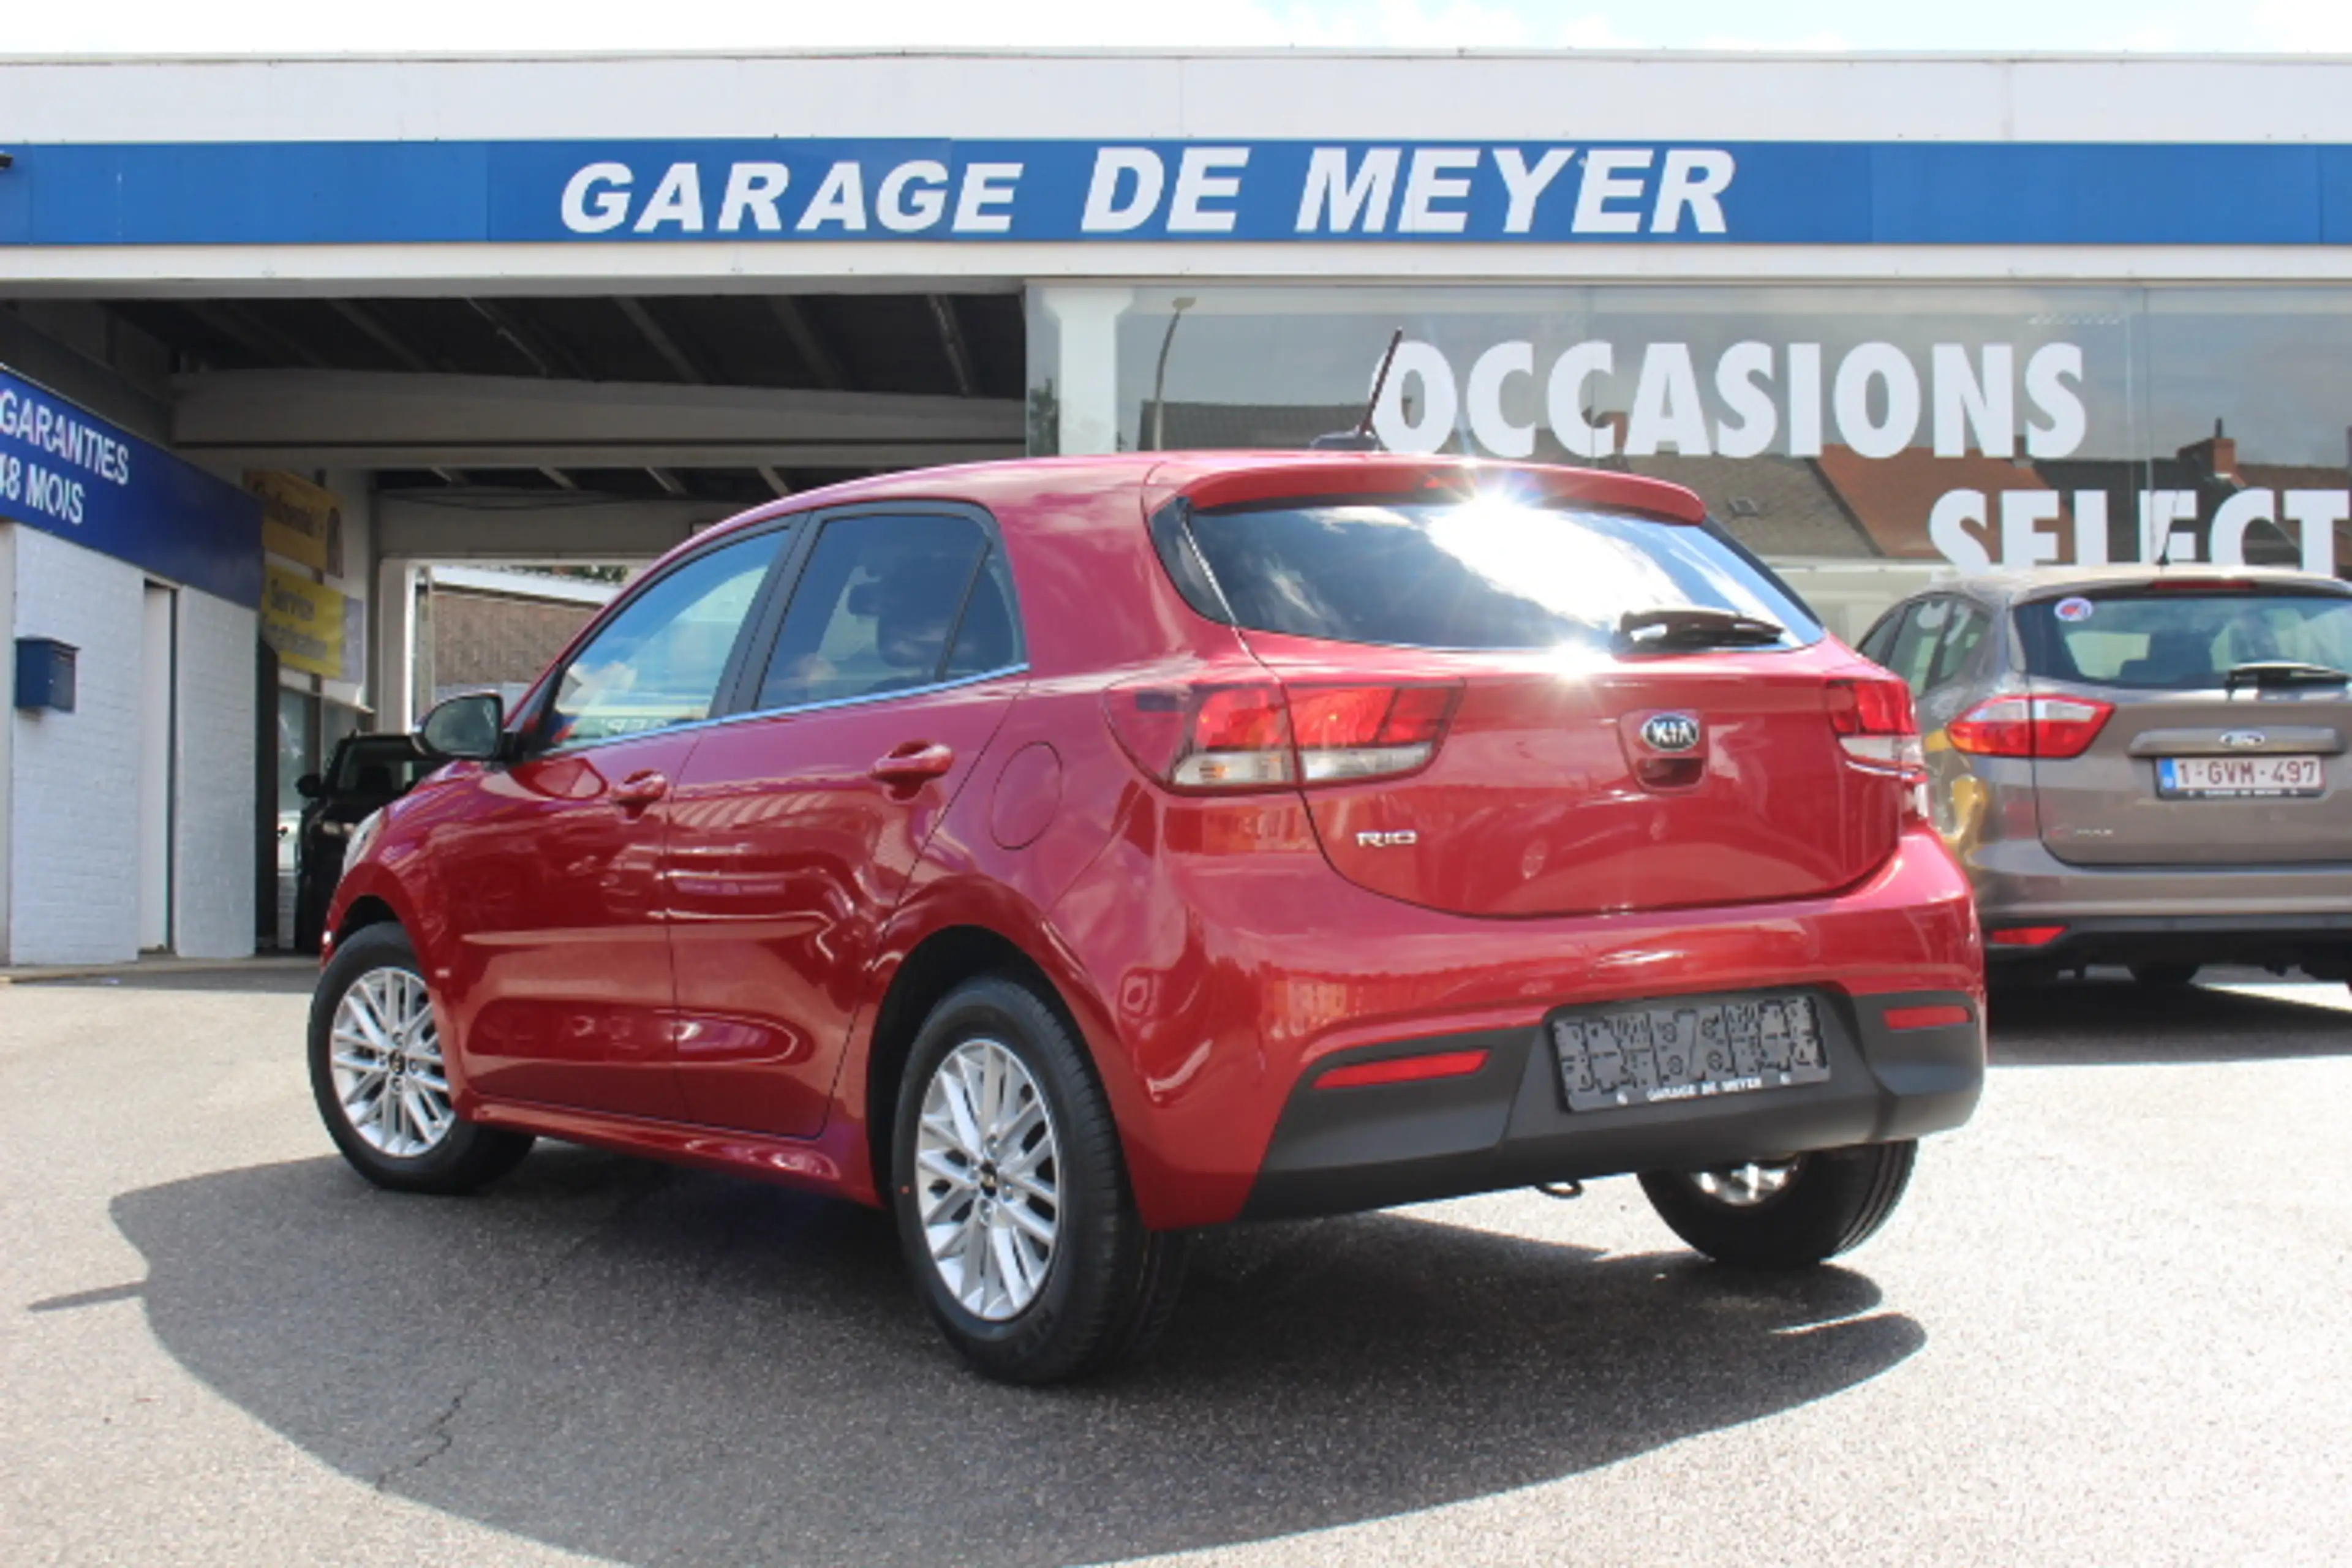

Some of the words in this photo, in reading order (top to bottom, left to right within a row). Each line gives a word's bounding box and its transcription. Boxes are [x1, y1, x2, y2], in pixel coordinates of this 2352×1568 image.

[560, 159, 1024, 234] GARAGE
[1080, 146, 1251, 233] DE
[1294, 146, 1736, 233] MEYER
[0, 388, 129, 485] GARANTIES
[1370, 340, 2087, 459] OCCASIONS
[25, 463, 85, 525] MOIS
[1652, 721, 1695, 744] KIA
[1355, 830, 1418, 848] RIO
